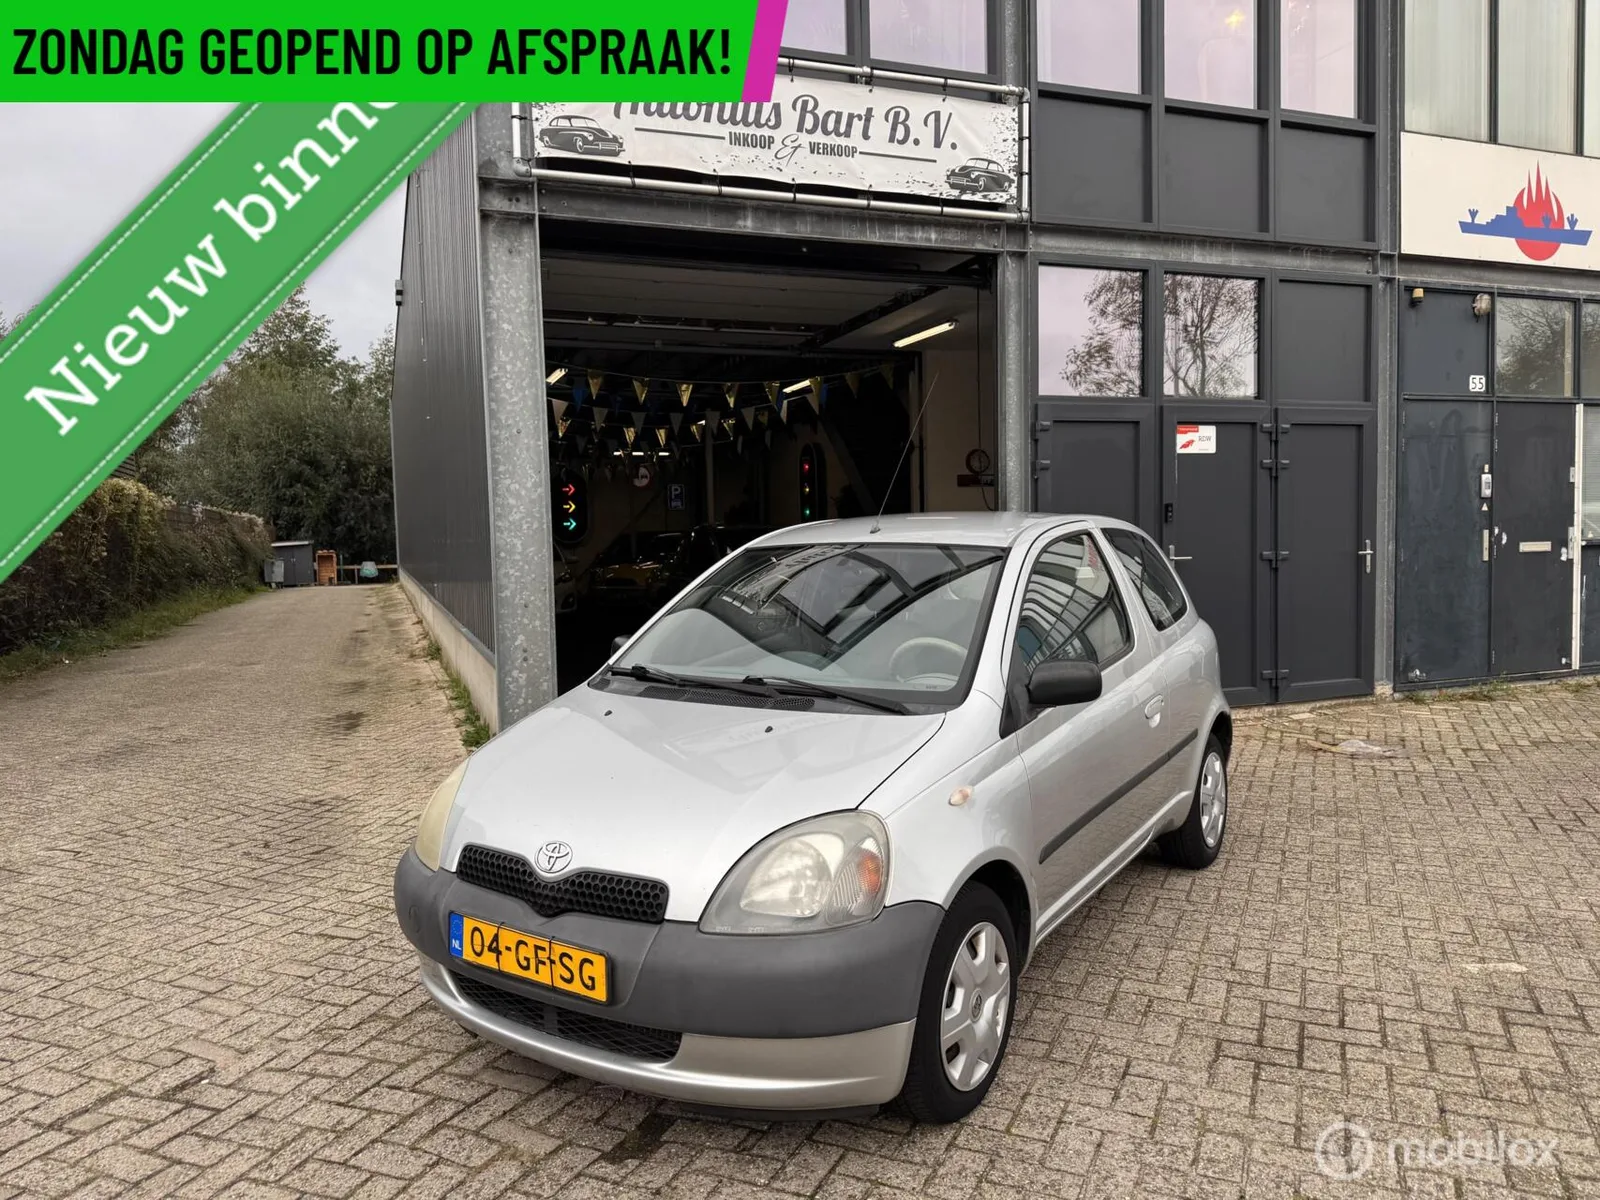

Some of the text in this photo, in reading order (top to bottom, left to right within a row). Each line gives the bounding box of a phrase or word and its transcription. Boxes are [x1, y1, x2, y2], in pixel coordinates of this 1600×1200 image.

[791, 94, 875, 141] Bart
[884, 105, 958, 151] B.V.
[728, 131, 775, 150] INKOOP
[808, 141, 858, 159] VERKOOP
[1471, 377, 1484, 390] 55
[671, 485, 681, 499] P
[452, 926, 596, 991] NL 04-GF-SG
